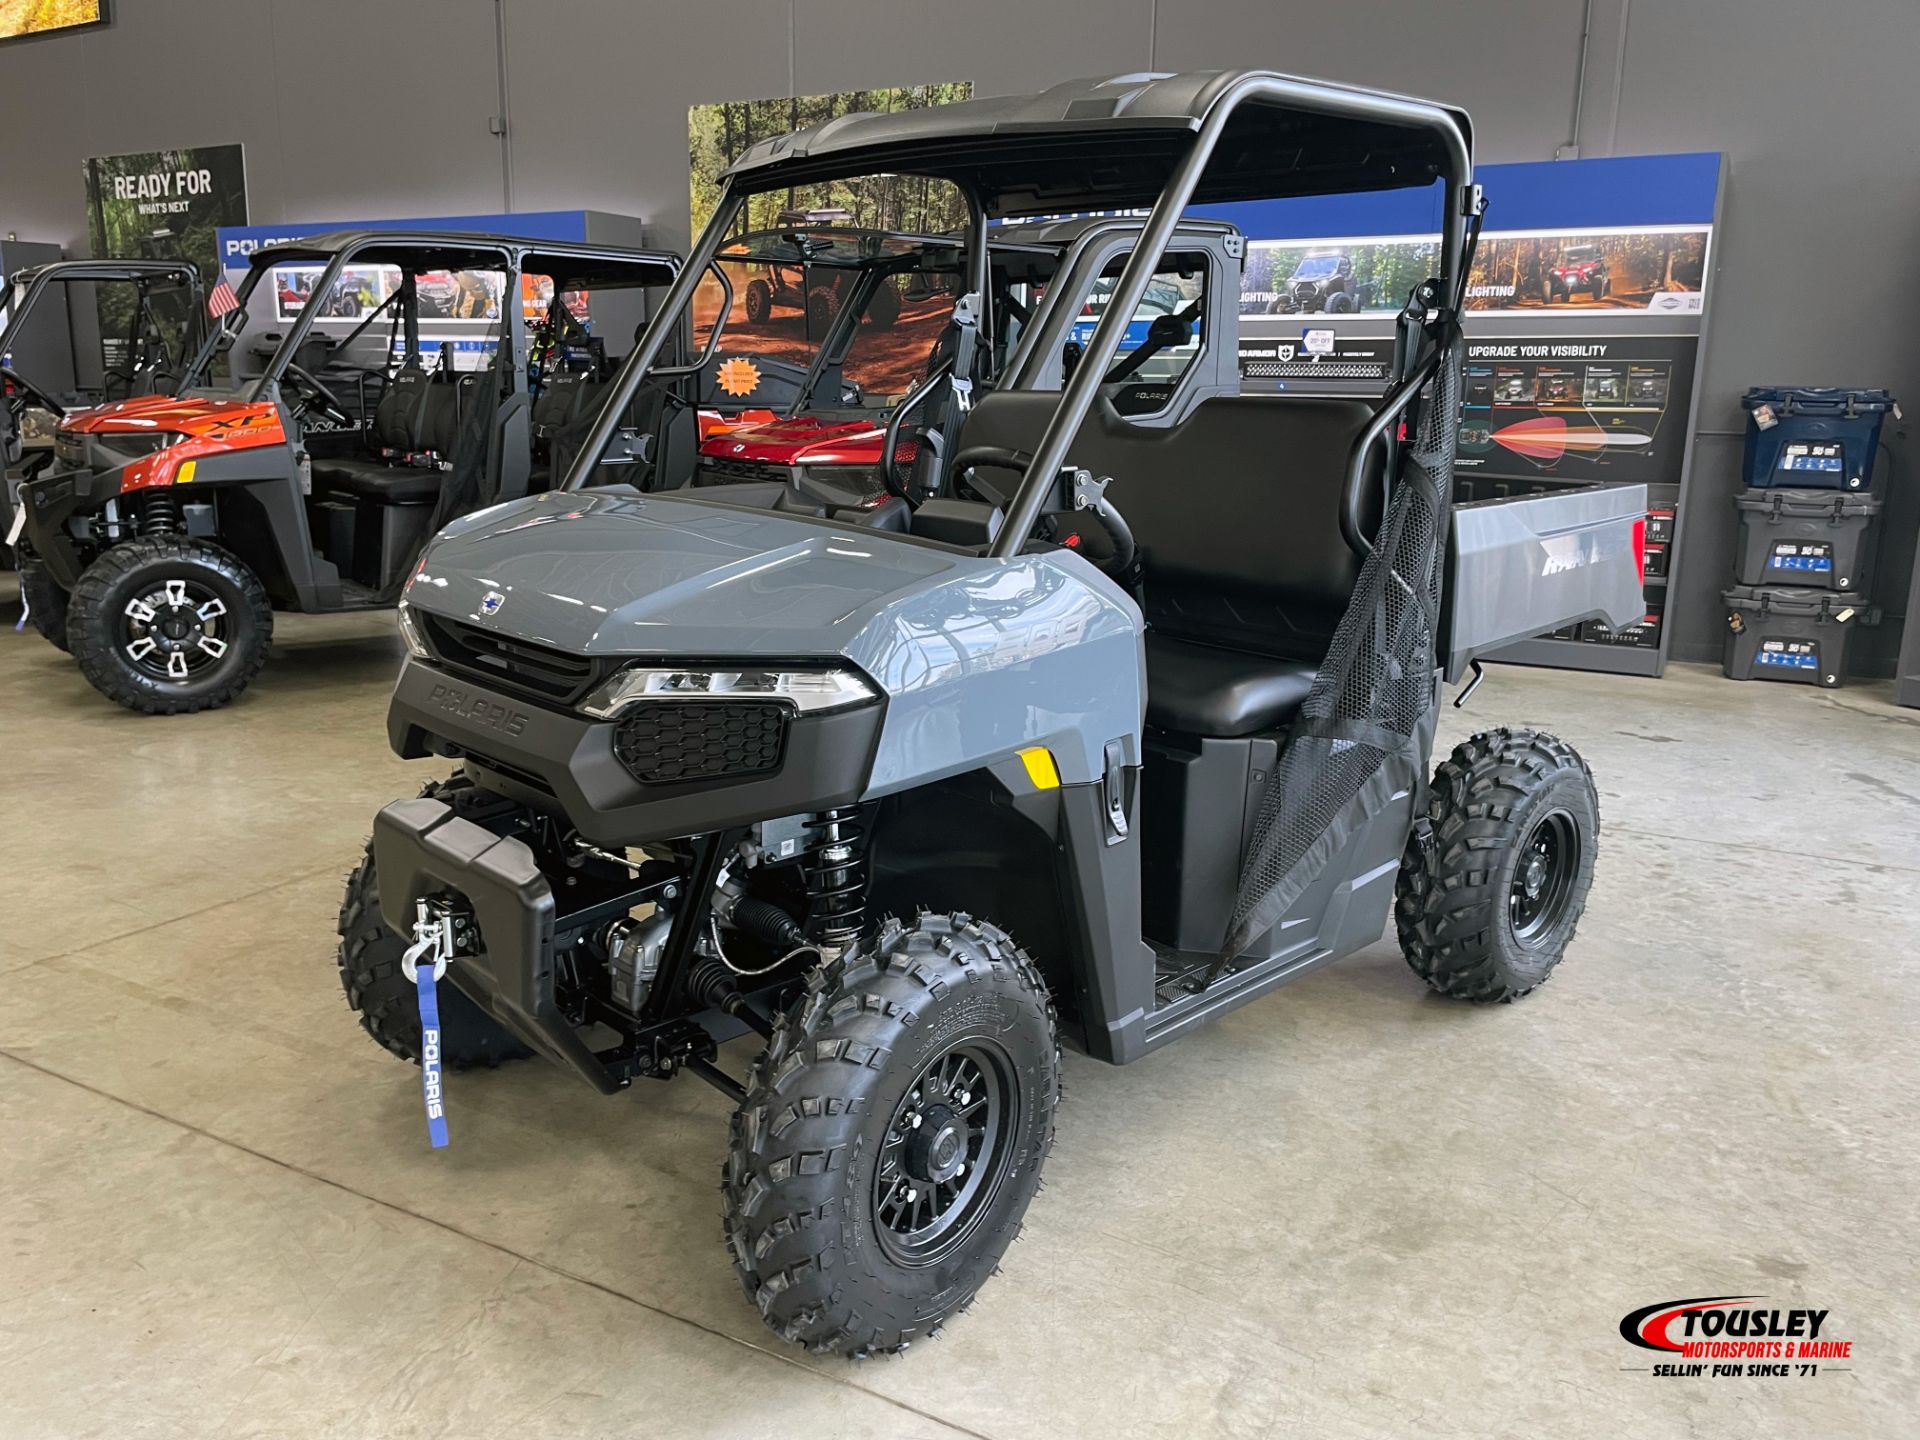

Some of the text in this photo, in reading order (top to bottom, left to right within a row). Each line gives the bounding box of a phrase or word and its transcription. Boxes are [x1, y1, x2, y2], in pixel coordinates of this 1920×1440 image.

[114, 169, 212, 200] READY FOR
[138, 201, 190, 215] WHAT'S NEXT
[1465, 286, 1515, 297] LIGHTING
[1468, 345, 1607, 357] UPGRADE YOUR VISIBILITY
[207, 412, 273, 432] XP
[427, 683, 531, 738] POLARIS
[424, 1029, 443, 1120] POLARIS
